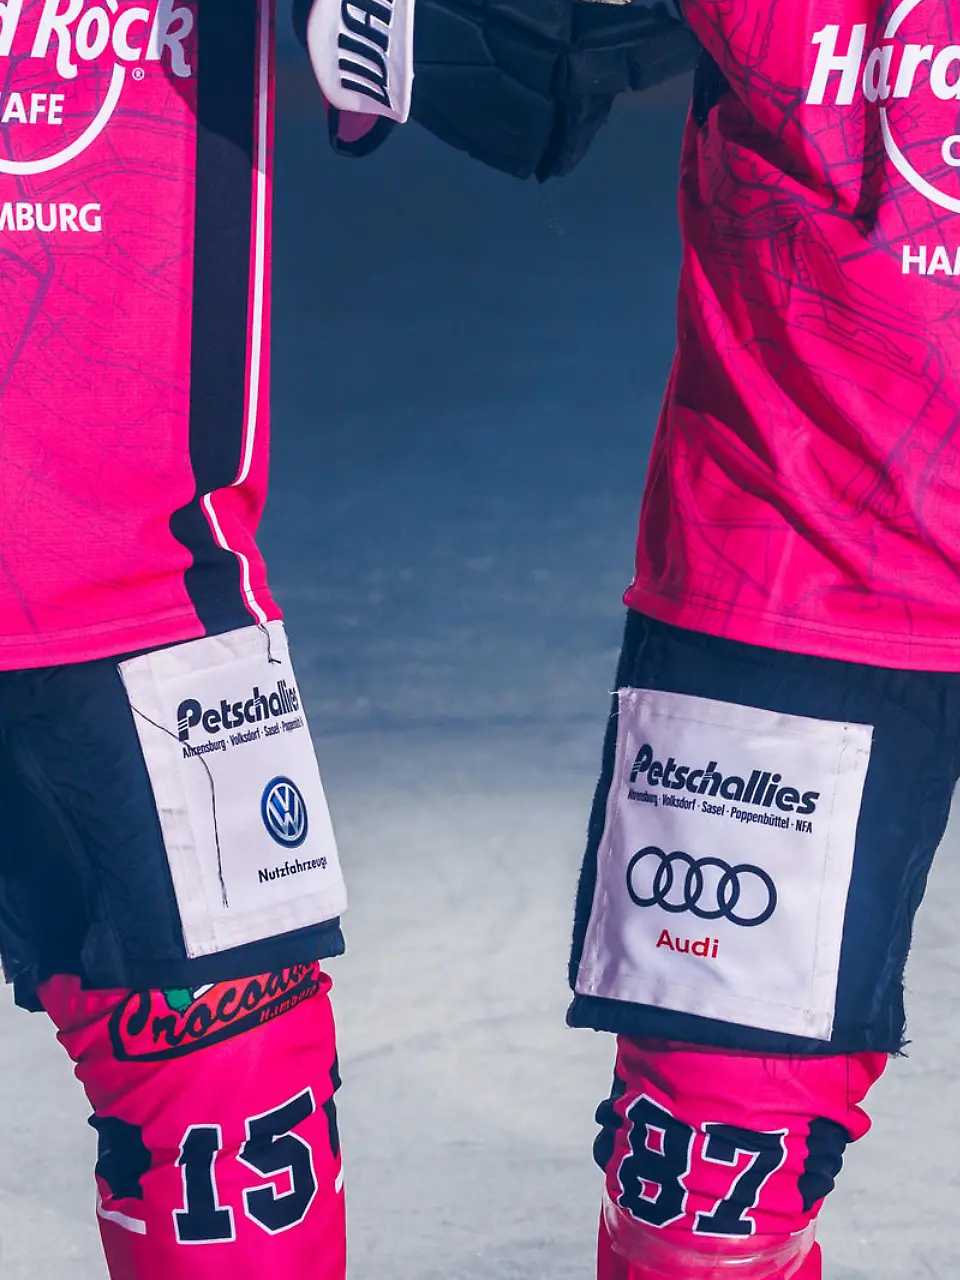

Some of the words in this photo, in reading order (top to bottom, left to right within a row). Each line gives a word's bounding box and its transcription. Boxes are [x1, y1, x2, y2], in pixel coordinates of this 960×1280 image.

[0, 92, 65, 125] AFE
[629, 743, 821, 815] Petschallies
[662, 793, 697, 811] Volksdorf
[701, 800, 725, 816] Sasel
[730, 806, 790, 829] Poppenbüttel
[795, 818, 813, 834] NFA
[656, 928, 719, 958] Audi
[172, 1086, 319, 1245] 15
[616, 1093, 790, 1239] 87
